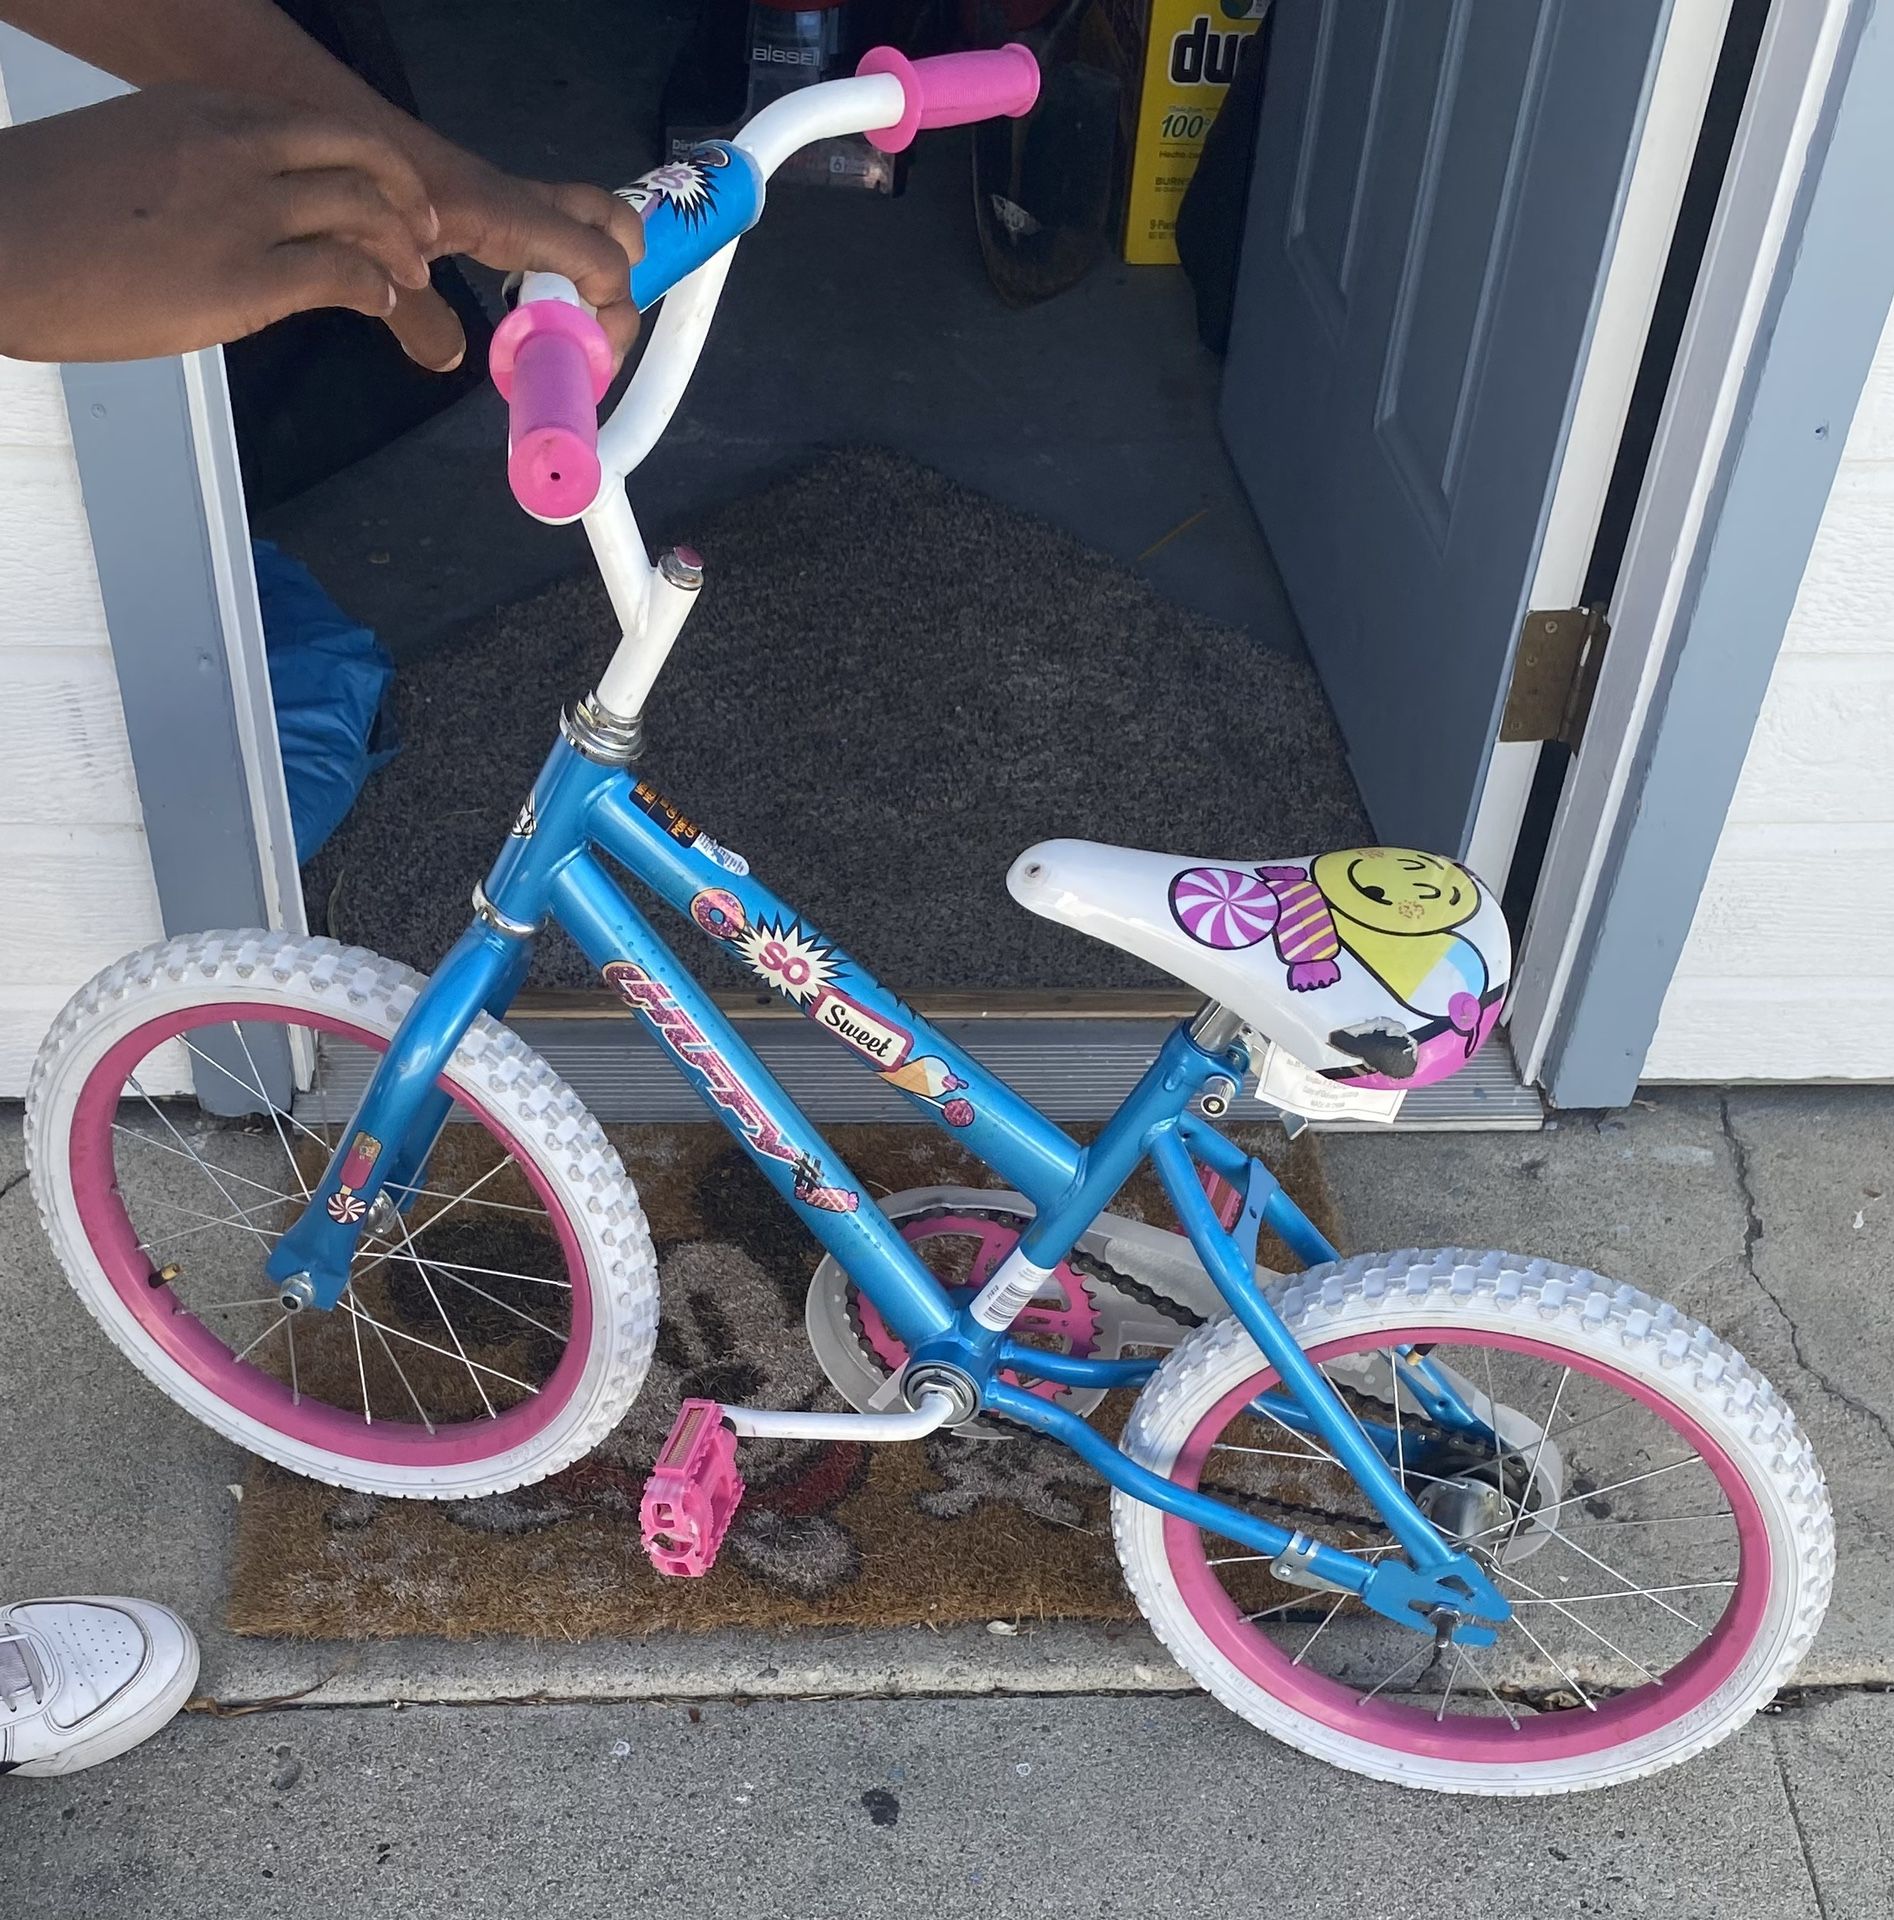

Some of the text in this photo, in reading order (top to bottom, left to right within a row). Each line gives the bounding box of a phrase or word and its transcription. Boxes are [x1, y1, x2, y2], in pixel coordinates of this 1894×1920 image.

[758, 941, 811, 986] SO
[824, 1003, 893, 1058] Sweet
[619, 979, 803, 1167] HUFFY
